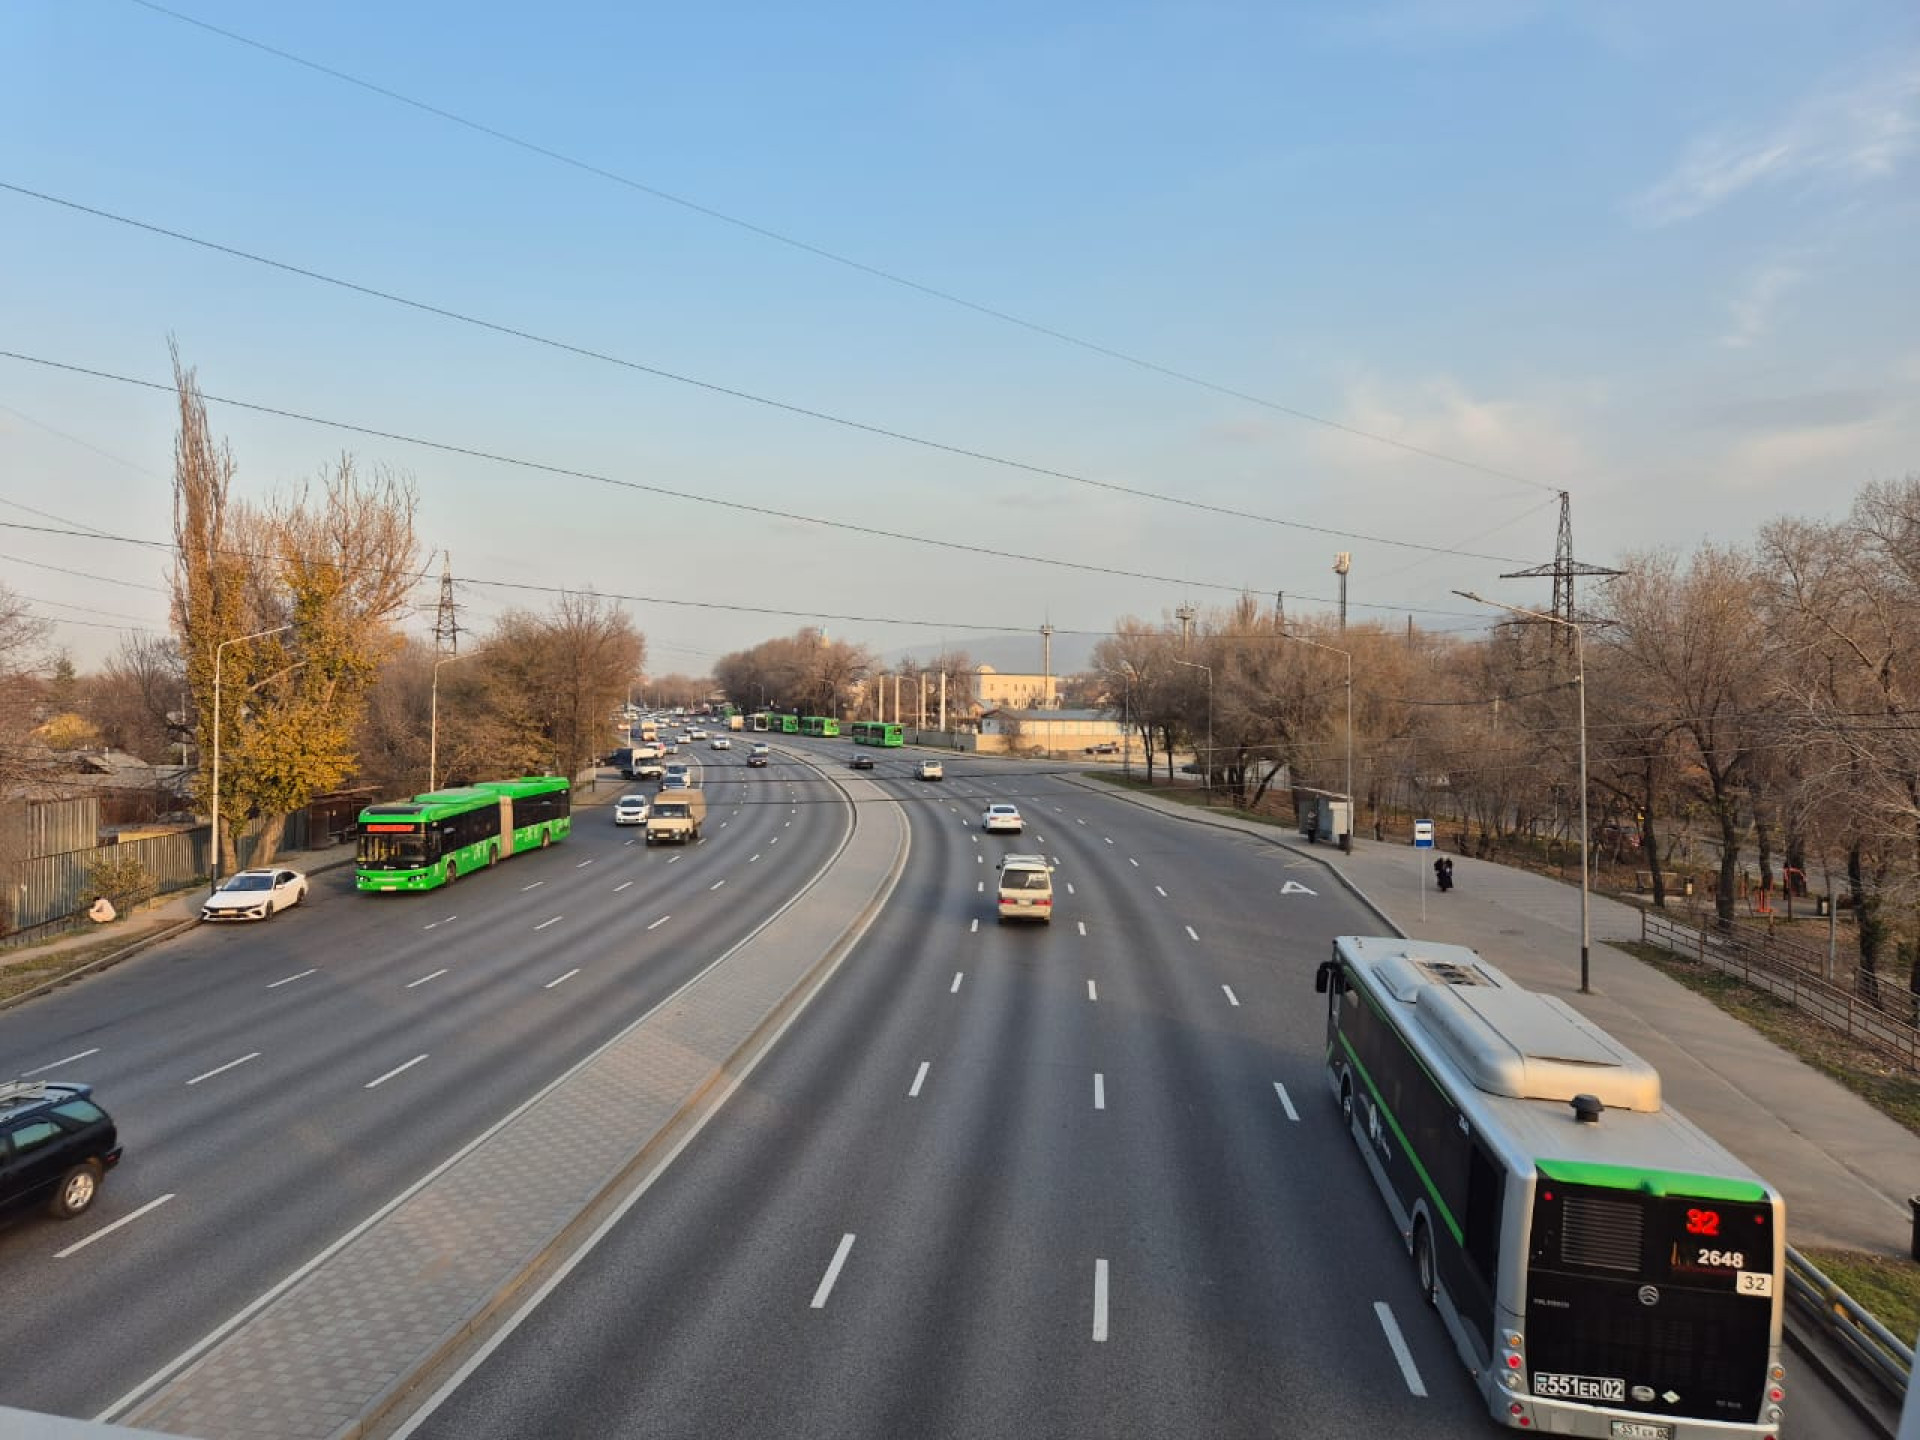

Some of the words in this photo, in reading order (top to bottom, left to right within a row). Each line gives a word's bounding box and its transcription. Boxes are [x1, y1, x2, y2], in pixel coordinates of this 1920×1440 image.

[1686, 1208, 1720, 1235] 32
[1698, 1248, 1744, 1268] 2648
[1745, 1275, 1765, 1291] 32
[1602, 1380, 1621, 1399] 02
